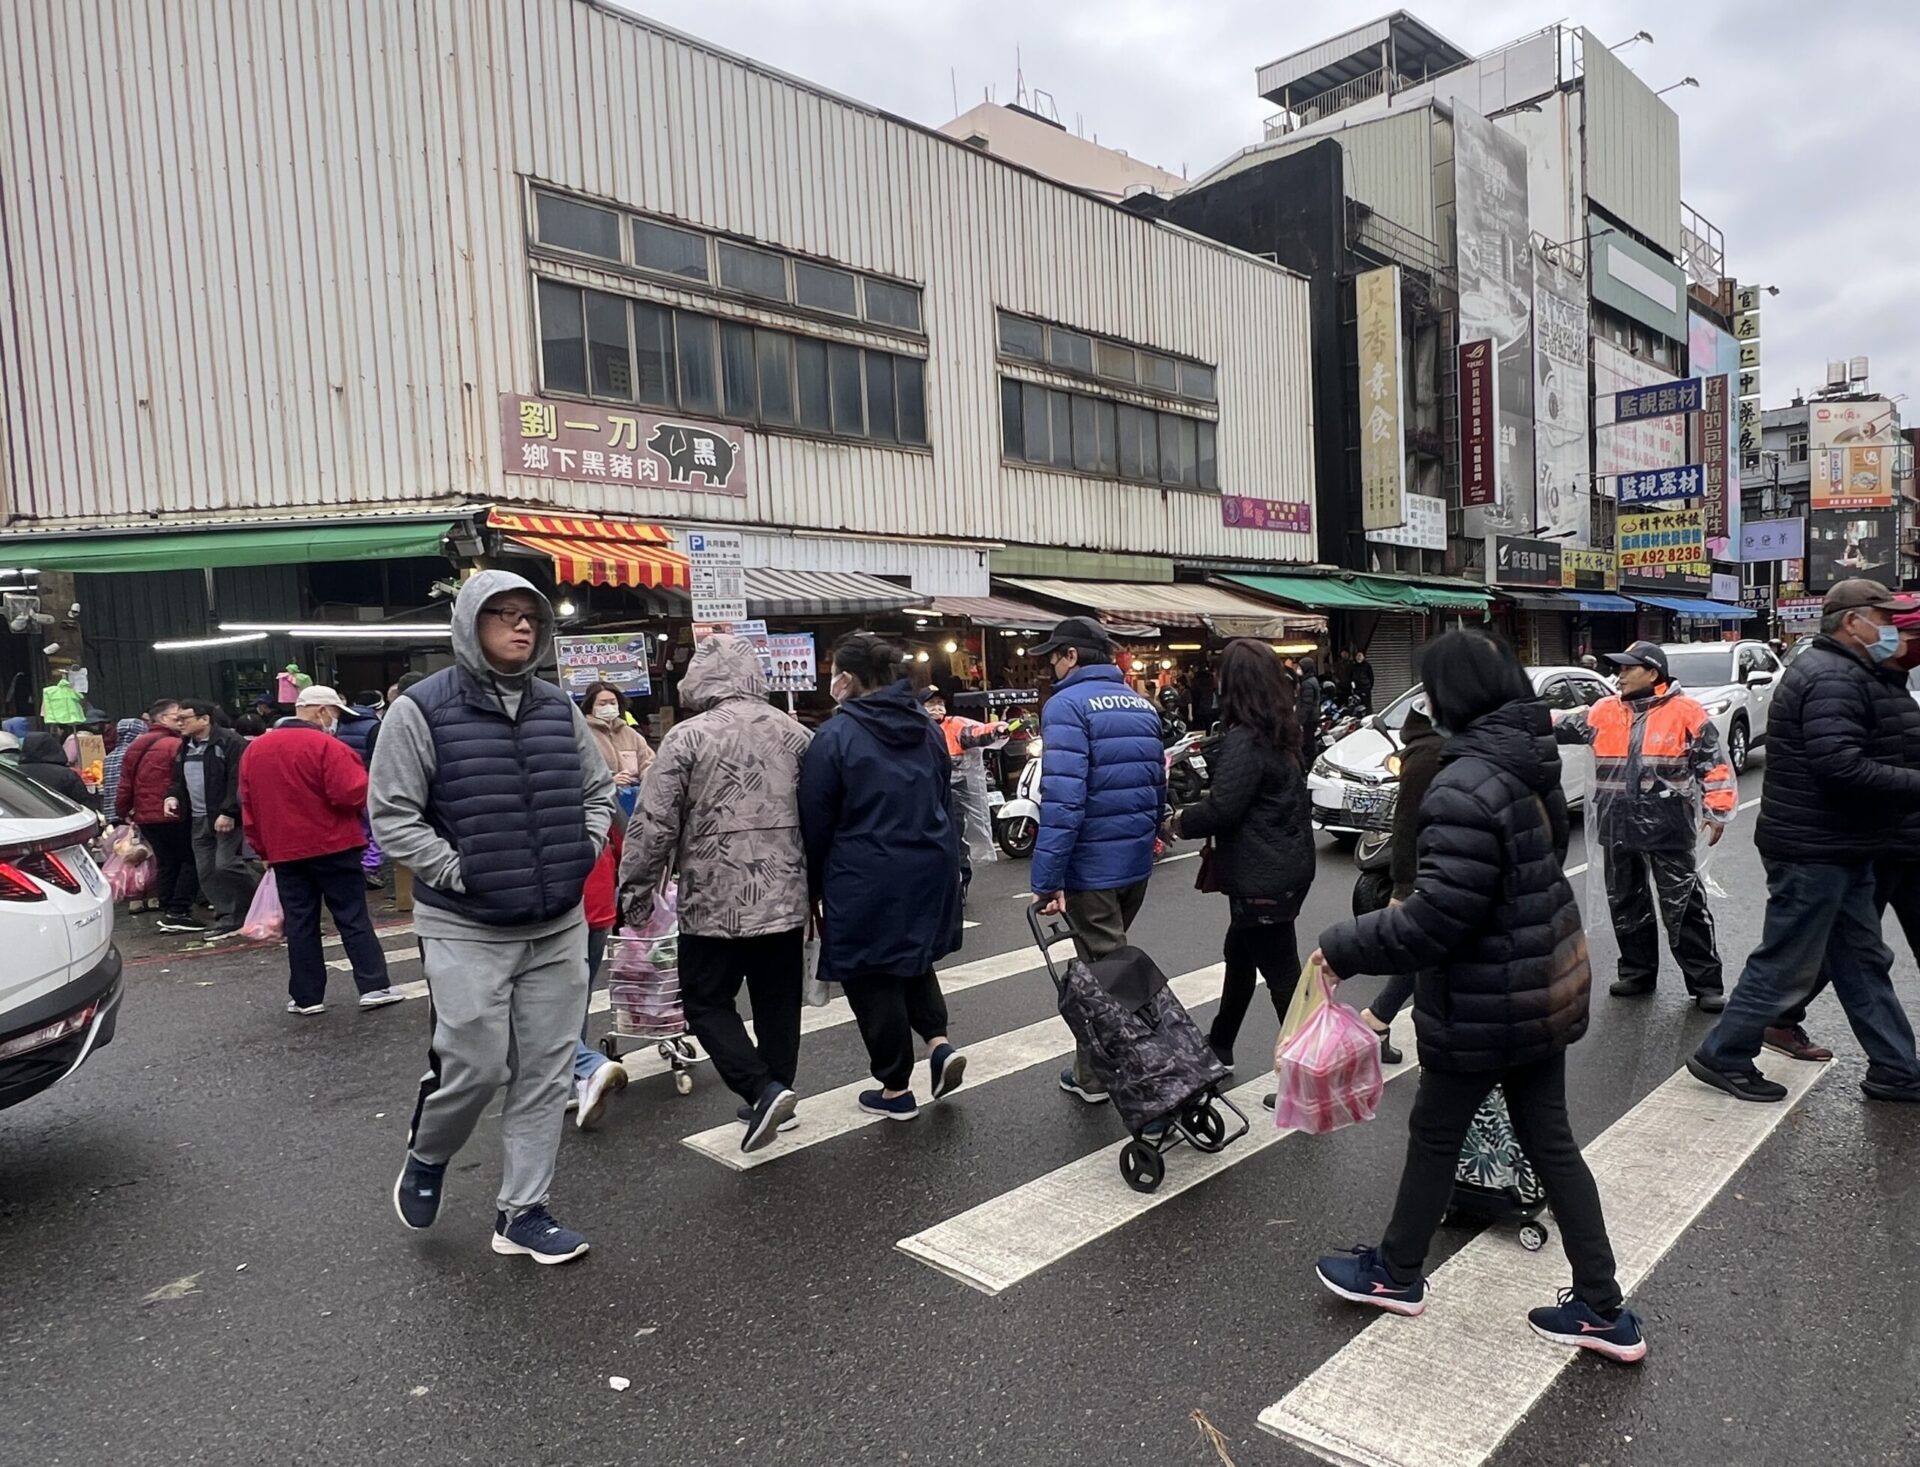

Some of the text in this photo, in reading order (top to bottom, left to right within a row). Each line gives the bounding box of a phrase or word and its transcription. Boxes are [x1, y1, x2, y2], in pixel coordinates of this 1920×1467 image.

[1738, 290, 1756, 449] 官存仁中藥房
[1620, 384, 1698, 418] 監視器材
[519, 400, 638, 450] 劉一刀
[522, 442, 659, 482] 鄉下黑豬肉
[693, 437, 717, 467] 黑
[1620, 468, 1699, 502] 監視器材
[1639, 512, 1702, 532] 利千代科技
[1564, 552, 1615, 572] 利千代科技
